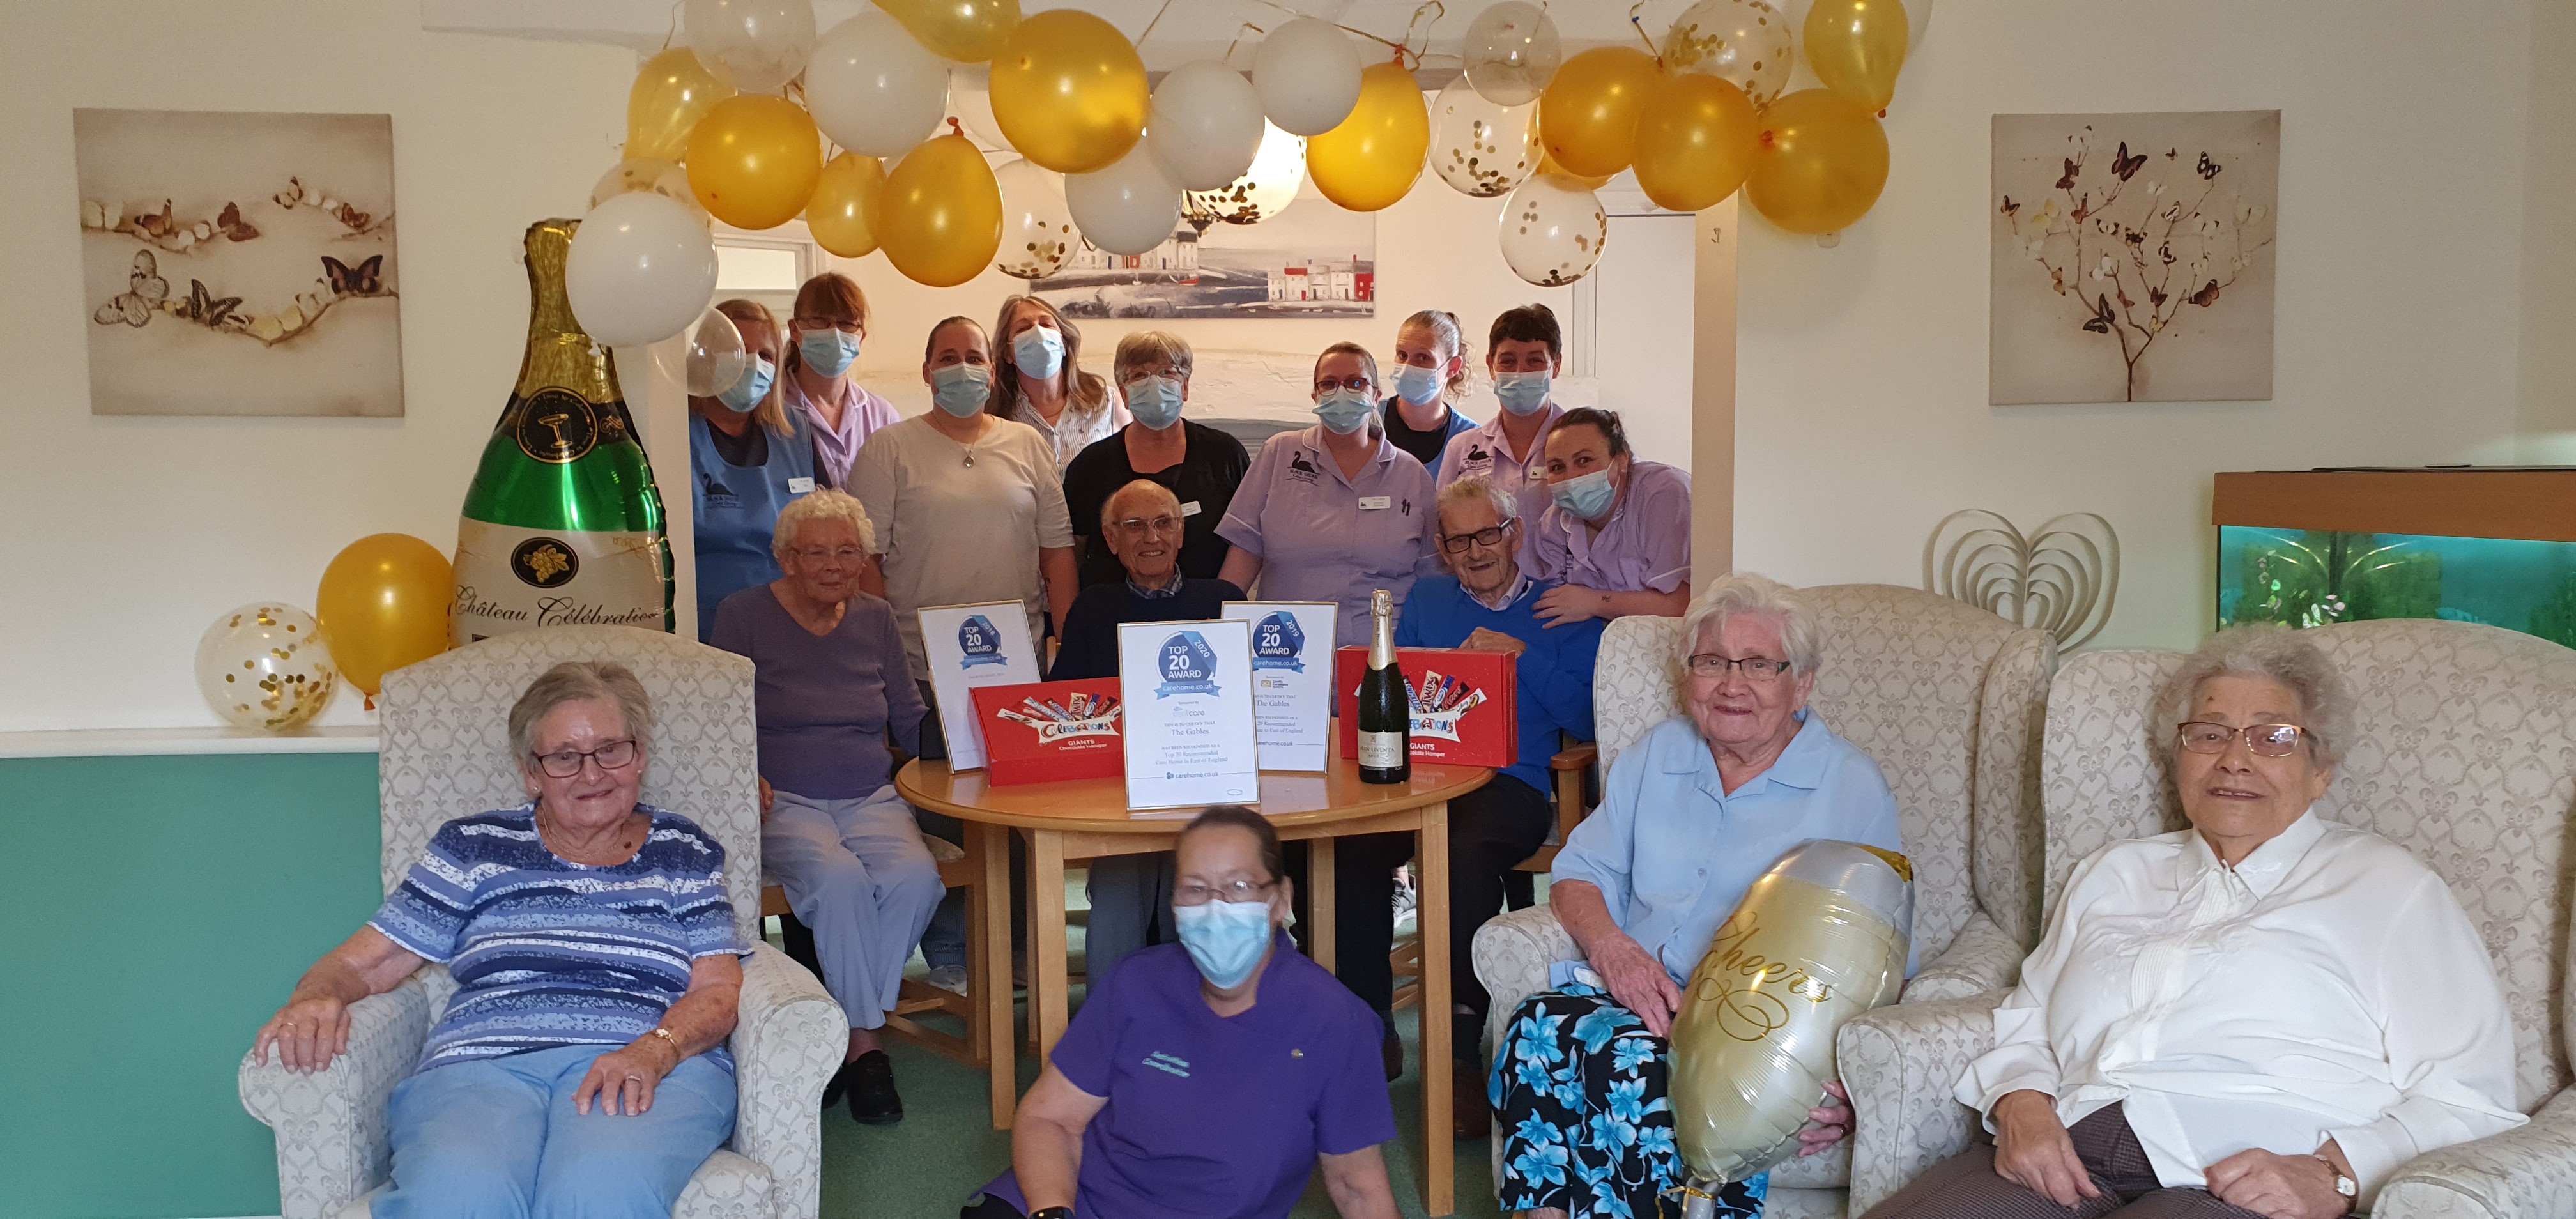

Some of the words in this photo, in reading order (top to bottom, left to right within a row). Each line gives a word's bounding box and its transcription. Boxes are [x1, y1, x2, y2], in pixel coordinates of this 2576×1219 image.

[455, 585, 528, 621] Château
[1262, 624, 1280, 632] TOP
[1286, 620, 1300, 637] 2019
[965, 633, 982, 647] 20
[1261, 632, 1280, 647] 20
[967, 645, 992, 653] AWARD
[1168, 646, 1188, 655] TOP
[1194, 640, 1210, 658] 2020
[1169, 655, 1190, 670] 20
[1167, 670, 1202, 679] AWARD
[1163, 683, 1213, 691] carehome.co.uk
[1422, 677, 1435, 706] TWIX
